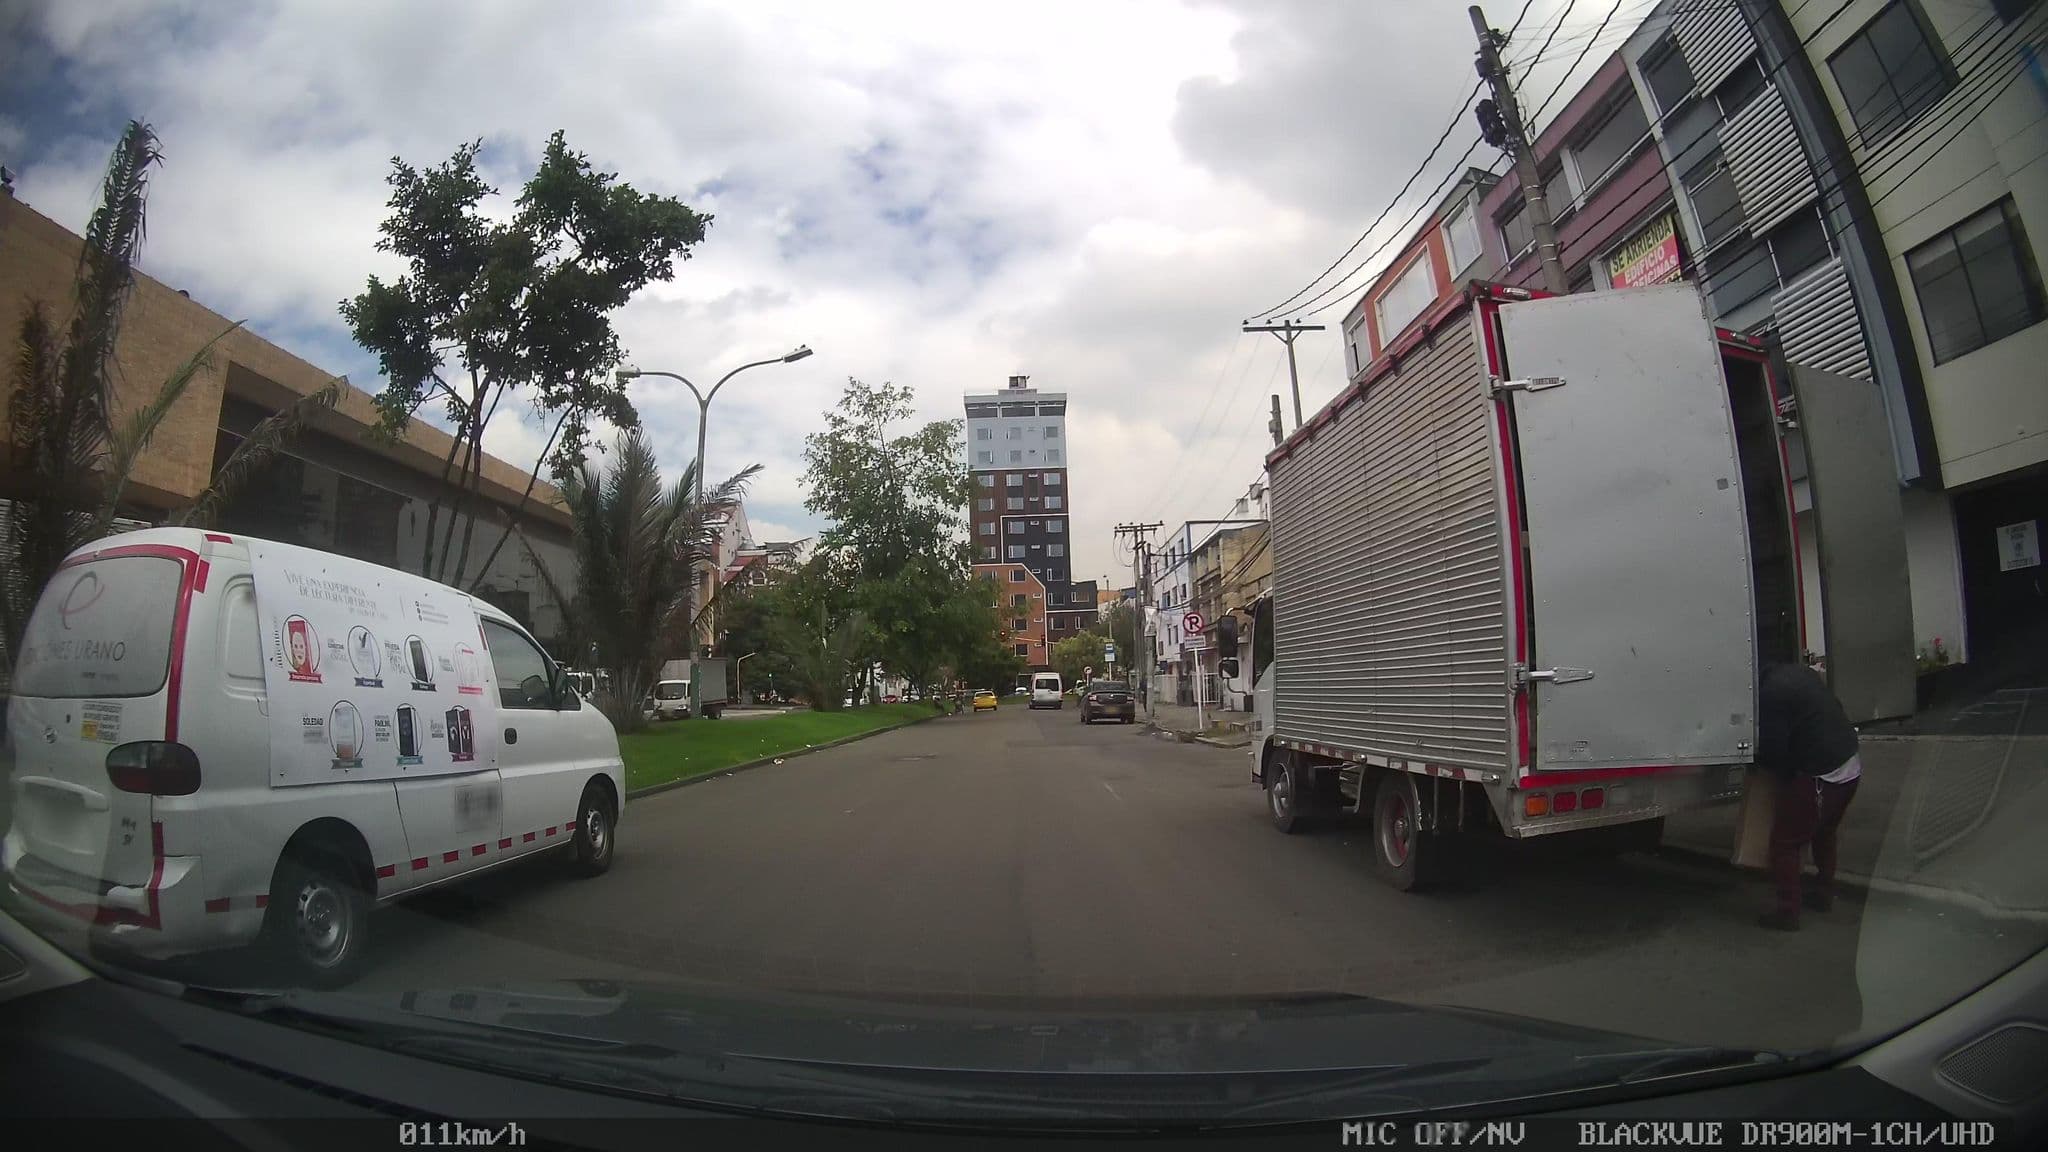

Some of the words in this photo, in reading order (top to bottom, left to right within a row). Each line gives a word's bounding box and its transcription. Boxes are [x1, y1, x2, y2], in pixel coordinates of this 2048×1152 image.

[1612, 251, 1625, 273] SE
[1626, 217, 1671, 264] ARRIENDA
[1625, 246, 1665, 285] EDIFICIO
[75, 640, 126, 662] URANO
[303, 717, 324, 726] SOLEDAD
